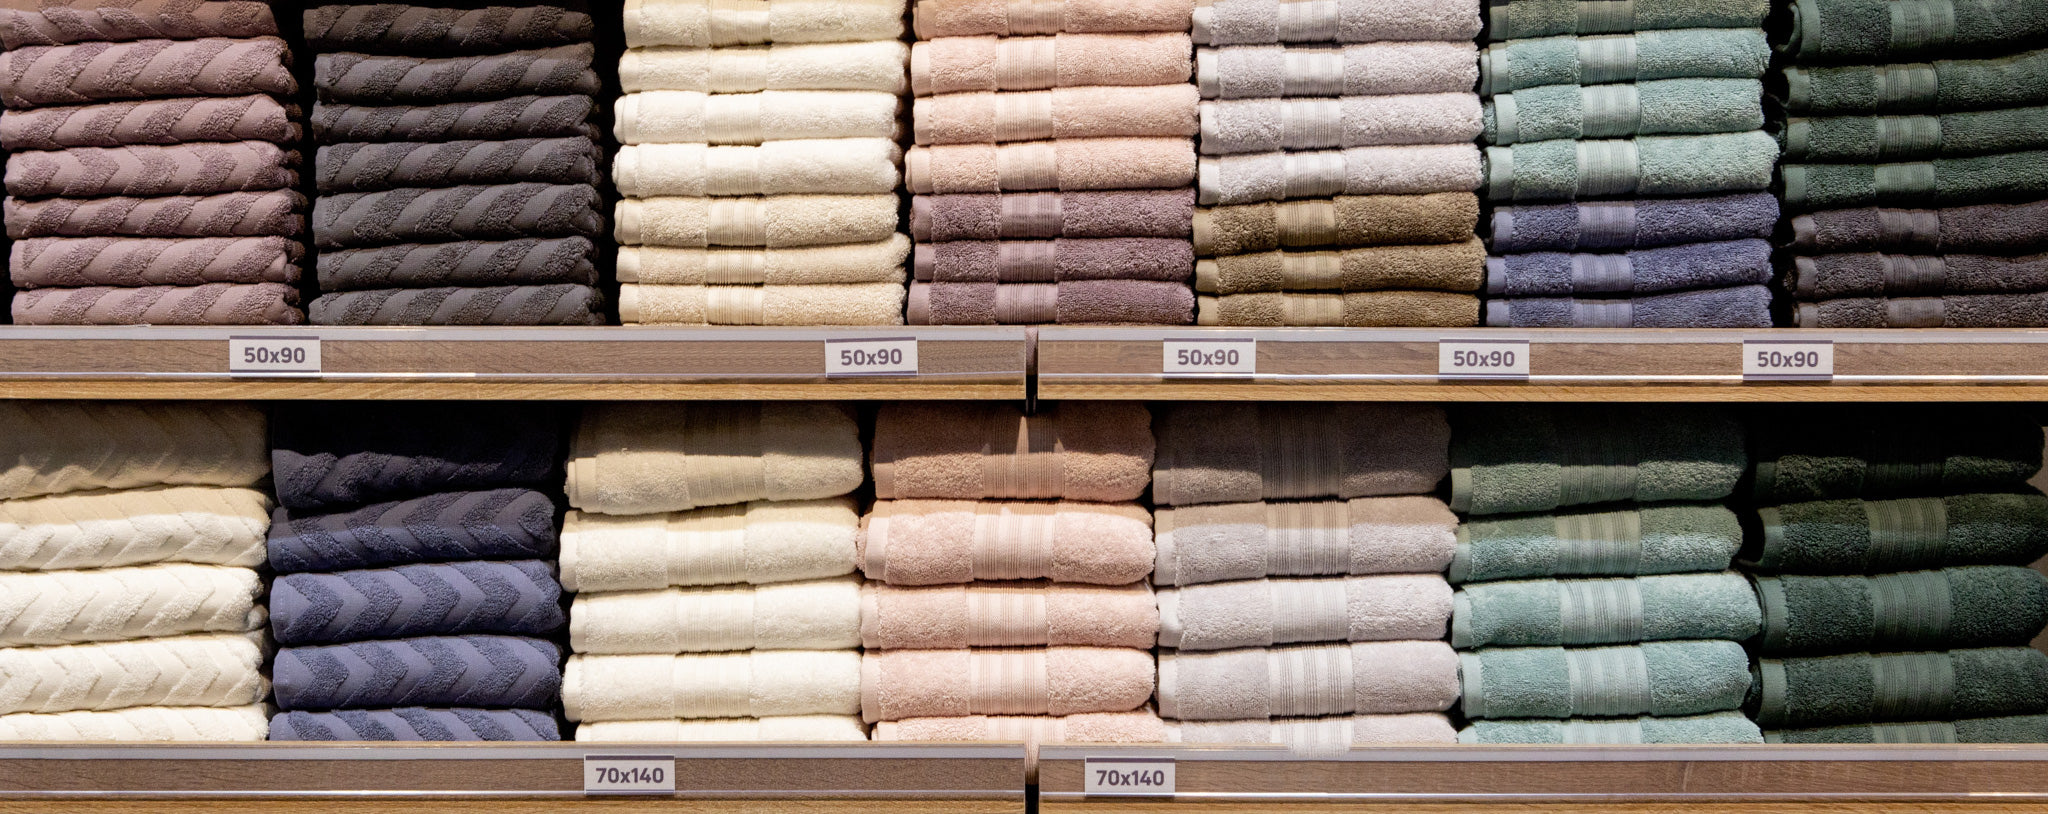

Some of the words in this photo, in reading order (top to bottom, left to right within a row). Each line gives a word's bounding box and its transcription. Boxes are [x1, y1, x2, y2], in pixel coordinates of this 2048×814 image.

[245, 347, 305, 363] 50x90
[841, 349, 902, 365] 50x90
[1178, 350, 1239, 365] 50x90
[1454, 351, 1514, 367] 50x90
[1758, 352, 1818, 367] 50x90
[596, 768, 663, 783] 70x140
[1097, 770, 1164, 786] 70x140
